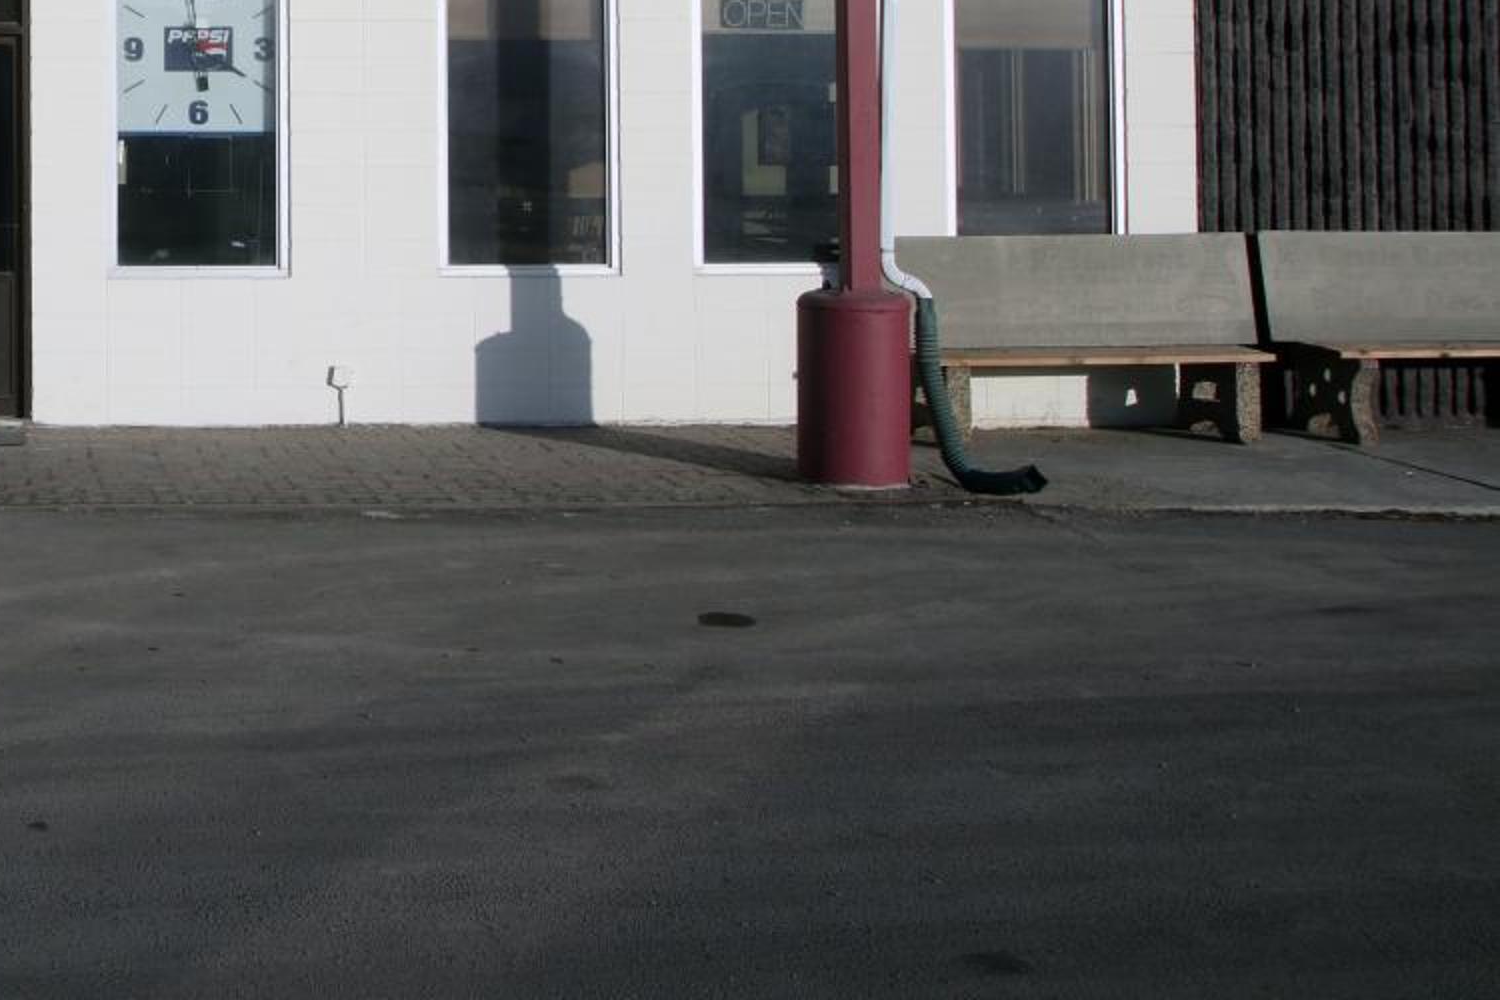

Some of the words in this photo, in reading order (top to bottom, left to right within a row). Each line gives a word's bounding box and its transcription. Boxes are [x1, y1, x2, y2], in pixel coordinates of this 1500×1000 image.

[723, 0, 805, 26] OPEN
[123, 37, 144, 62] 9
[254, 37, 274, 61] 3
[188, 99, 209, 125] 6
